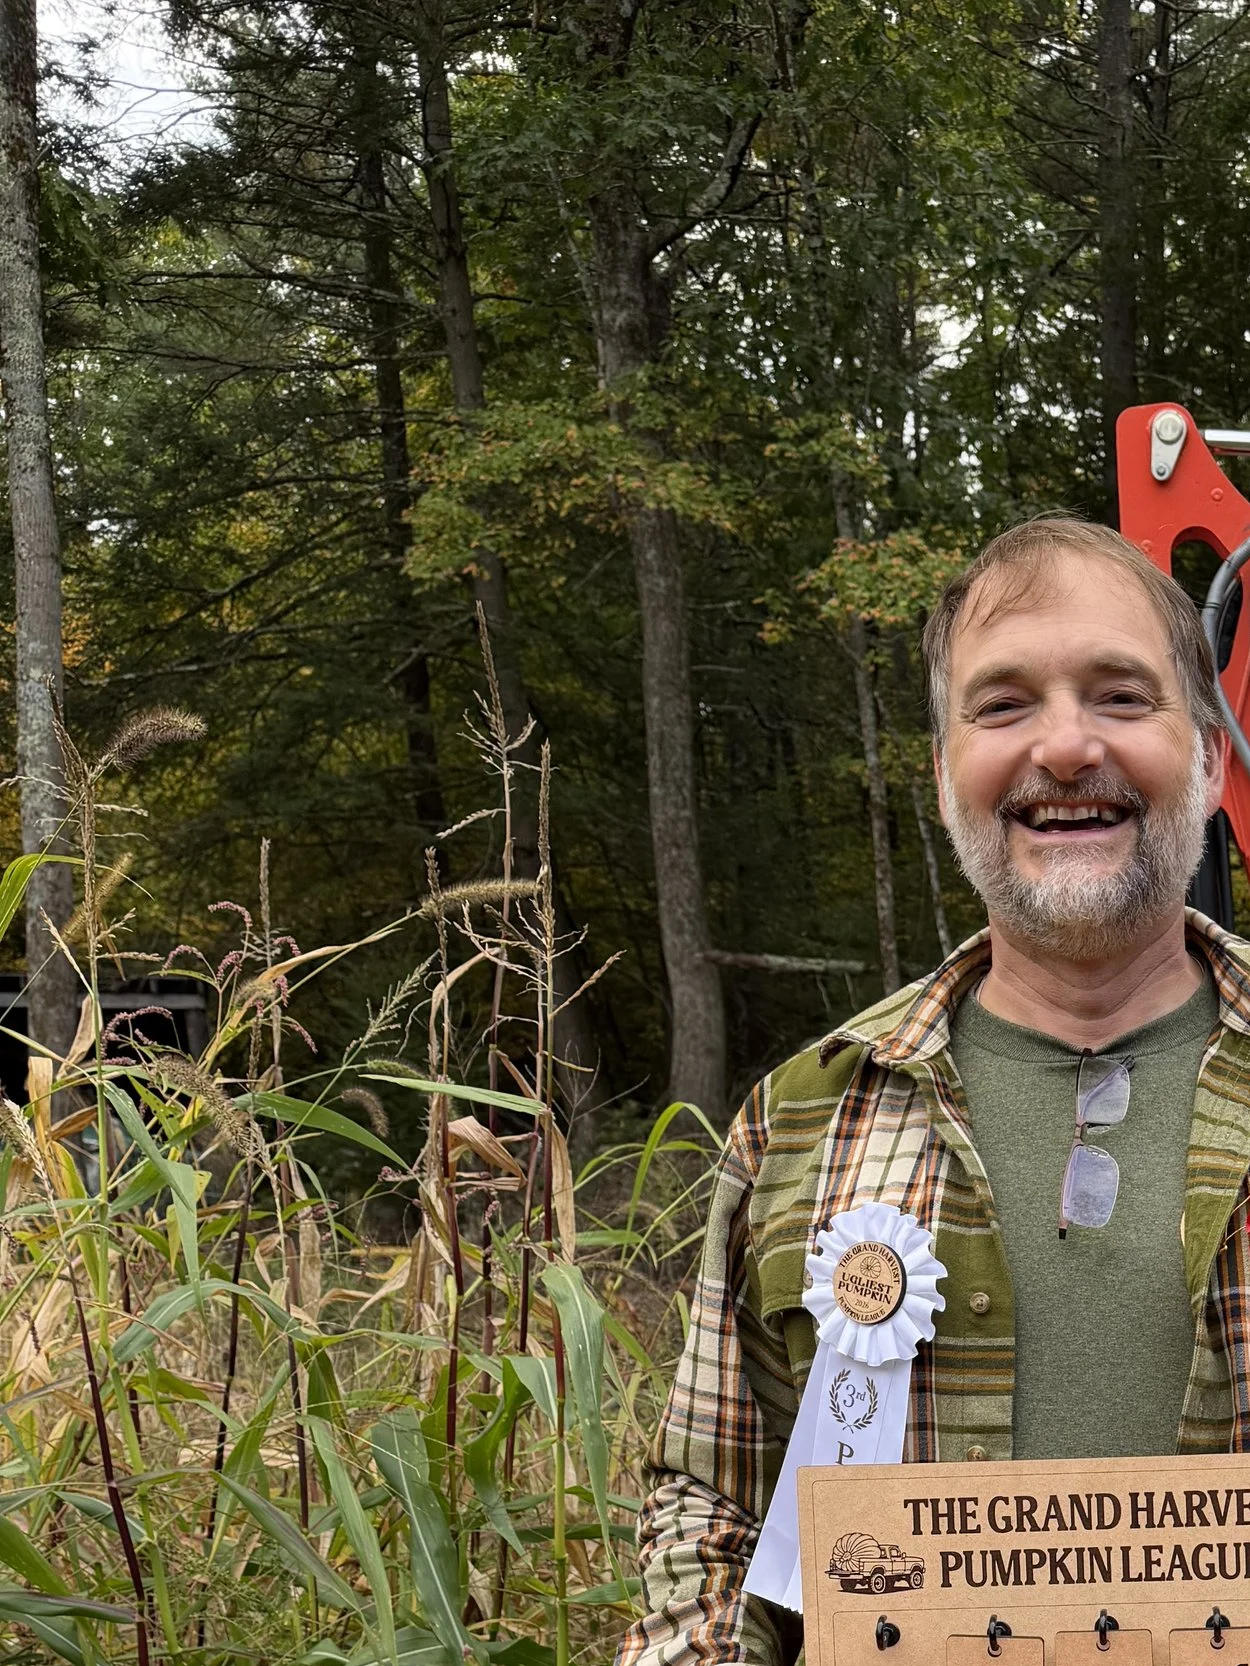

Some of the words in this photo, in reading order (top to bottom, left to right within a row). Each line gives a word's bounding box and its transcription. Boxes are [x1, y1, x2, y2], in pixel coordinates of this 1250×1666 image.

[839, 1251, 853, 1268] THE
[852, 1243, 879, 1255] GRAND
[878, 1246, 900, 1284] HARVEST
[838, 1280, 893, 1305] PUMPKIN
[842, 1272, 894, 1294] UGLIEST
[843, 1384, 867, 1408] 3rd
[904, 1497, 981, 1535] THE
[988, 1493, 1122, 1534] GRAND
[940, 1546, 1113, 1588] PUMPKIN
